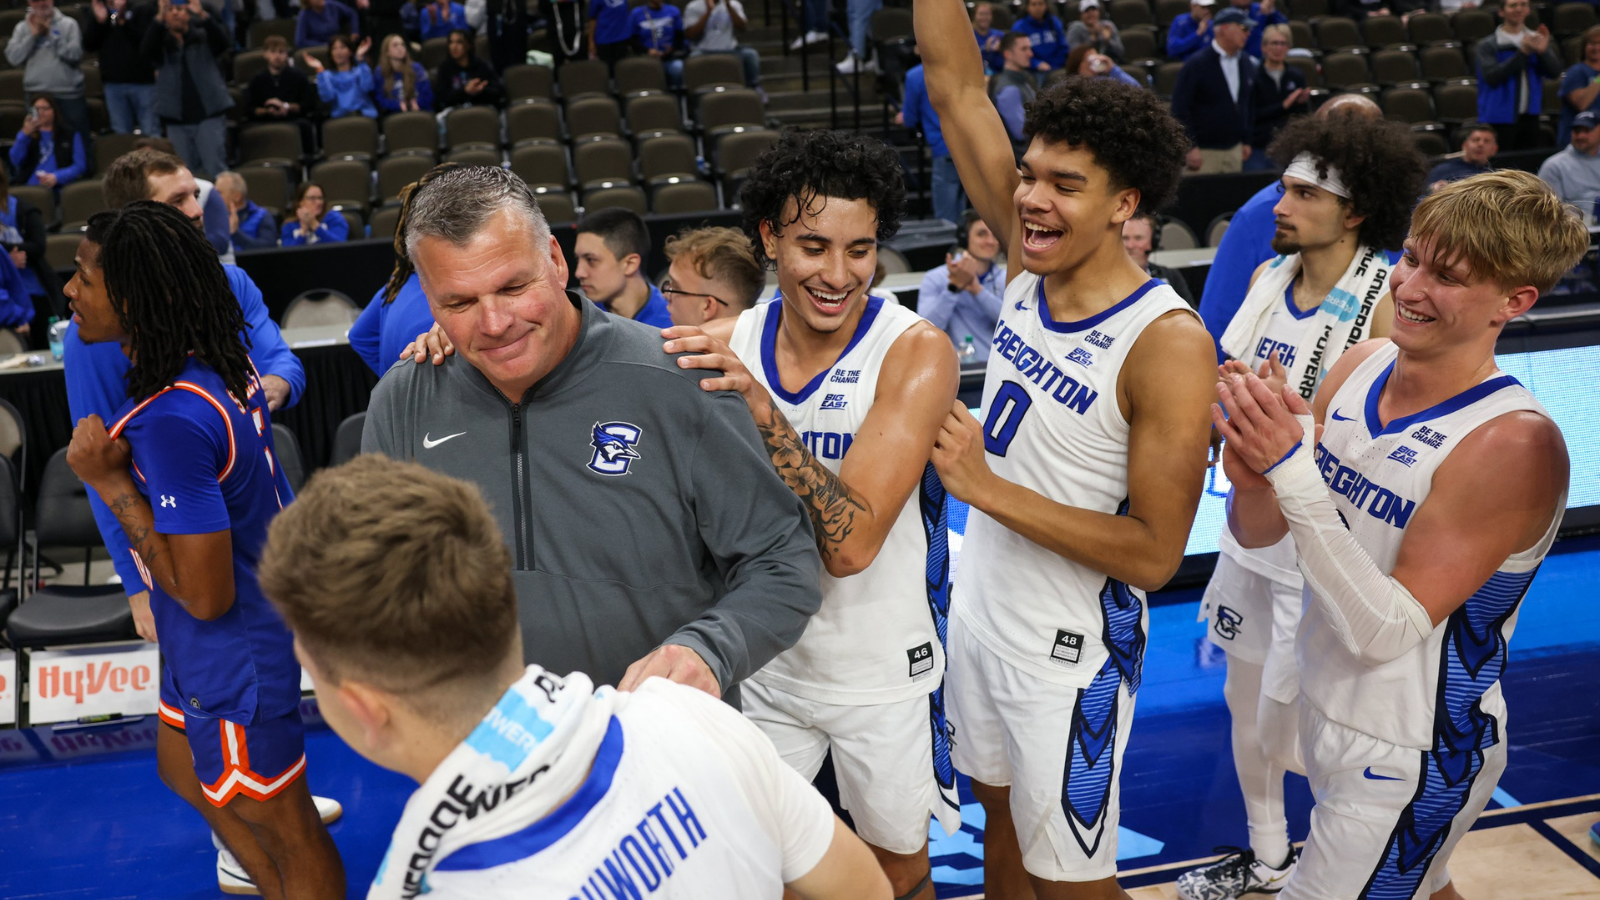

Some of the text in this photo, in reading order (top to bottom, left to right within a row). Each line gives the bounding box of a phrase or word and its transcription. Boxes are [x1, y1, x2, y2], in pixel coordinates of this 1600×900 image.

[1084, 335, 1112, 350] CHANGE
[1090, 330, 1115, 344] BE THE
[1073, 347, 1093, 359] BIG
[1068, 353, 1094, 367] EAST
[835, 368, 861, 377] BE THE
[830, 375, 859, 384] CHANGE
[821, 400, 848, 409] EAST
[983, 380, 1032, 458] 0
[1411, 431, 1443, 449] CHANGE
[1419, 425, 1447, 442] BE THE
[1397, 445, 1418, 457] BIG
[1391, 451, 1417, 466] EAST
[1061, 635, 1077, 645] 48
[914, 647, 928, 660] 46
